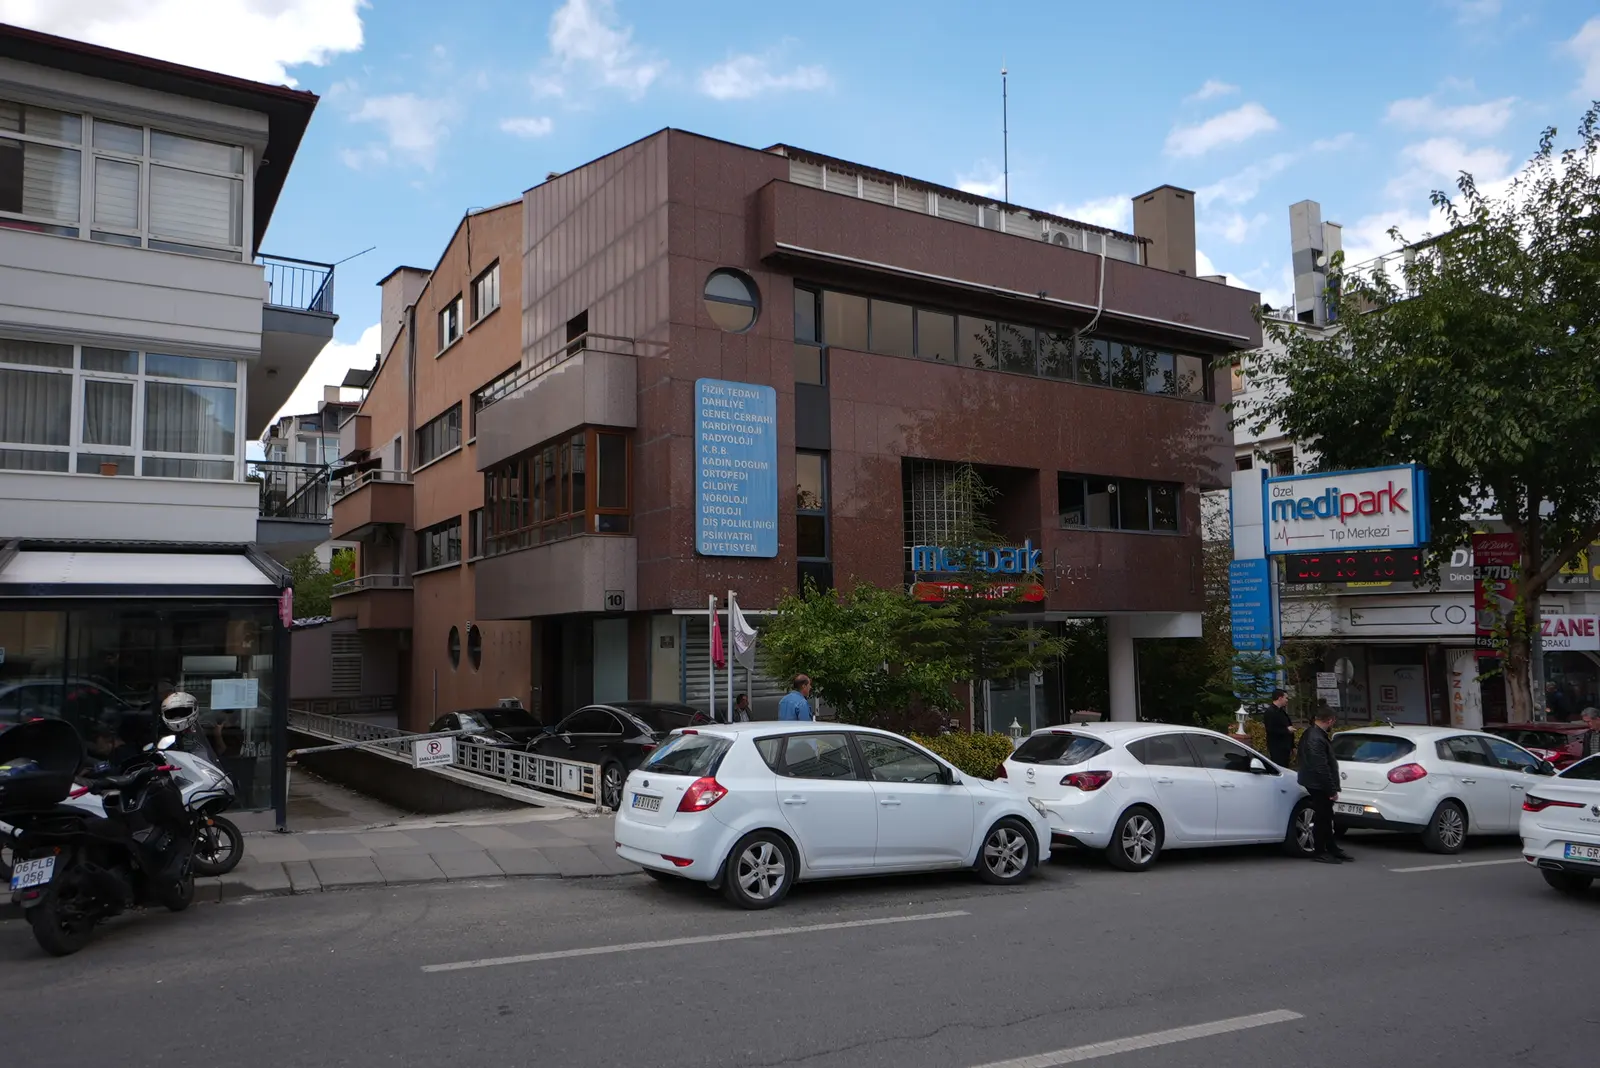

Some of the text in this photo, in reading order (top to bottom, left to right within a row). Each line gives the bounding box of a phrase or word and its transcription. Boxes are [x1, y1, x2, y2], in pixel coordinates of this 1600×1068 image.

[702, 409, 731, 420] GENEL
[1272, 485, 1294, 498] Özel
[1271, 481, 1408, 525] medipark
[1347, 525, 1390, 538] Merkezi
[911, 539, 1043, 574] mepark
[607, 594, 622, 606] 10
